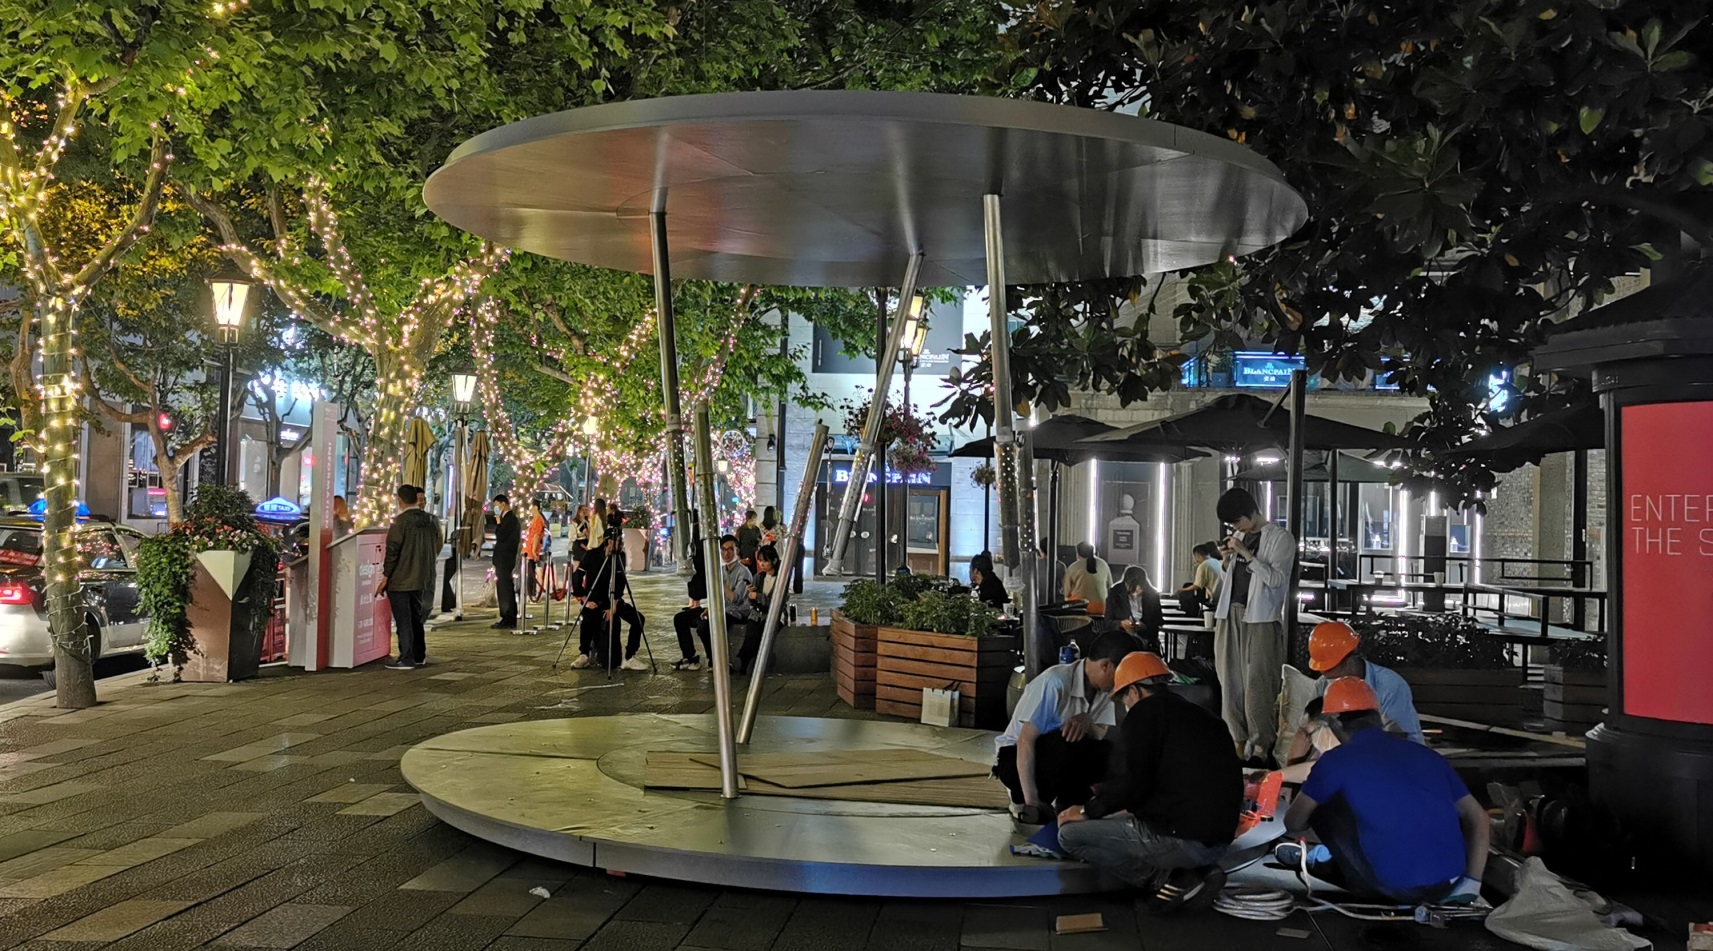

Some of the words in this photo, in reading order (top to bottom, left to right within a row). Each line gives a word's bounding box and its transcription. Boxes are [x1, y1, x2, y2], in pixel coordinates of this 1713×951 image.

[1243, 367, 1296, 375] BLANCPAIN
[324, 442, 332, 529] INFORMATION
[835, 469, 931, 484] BNCPIN
[1631, 527, 1682, 556] THE
